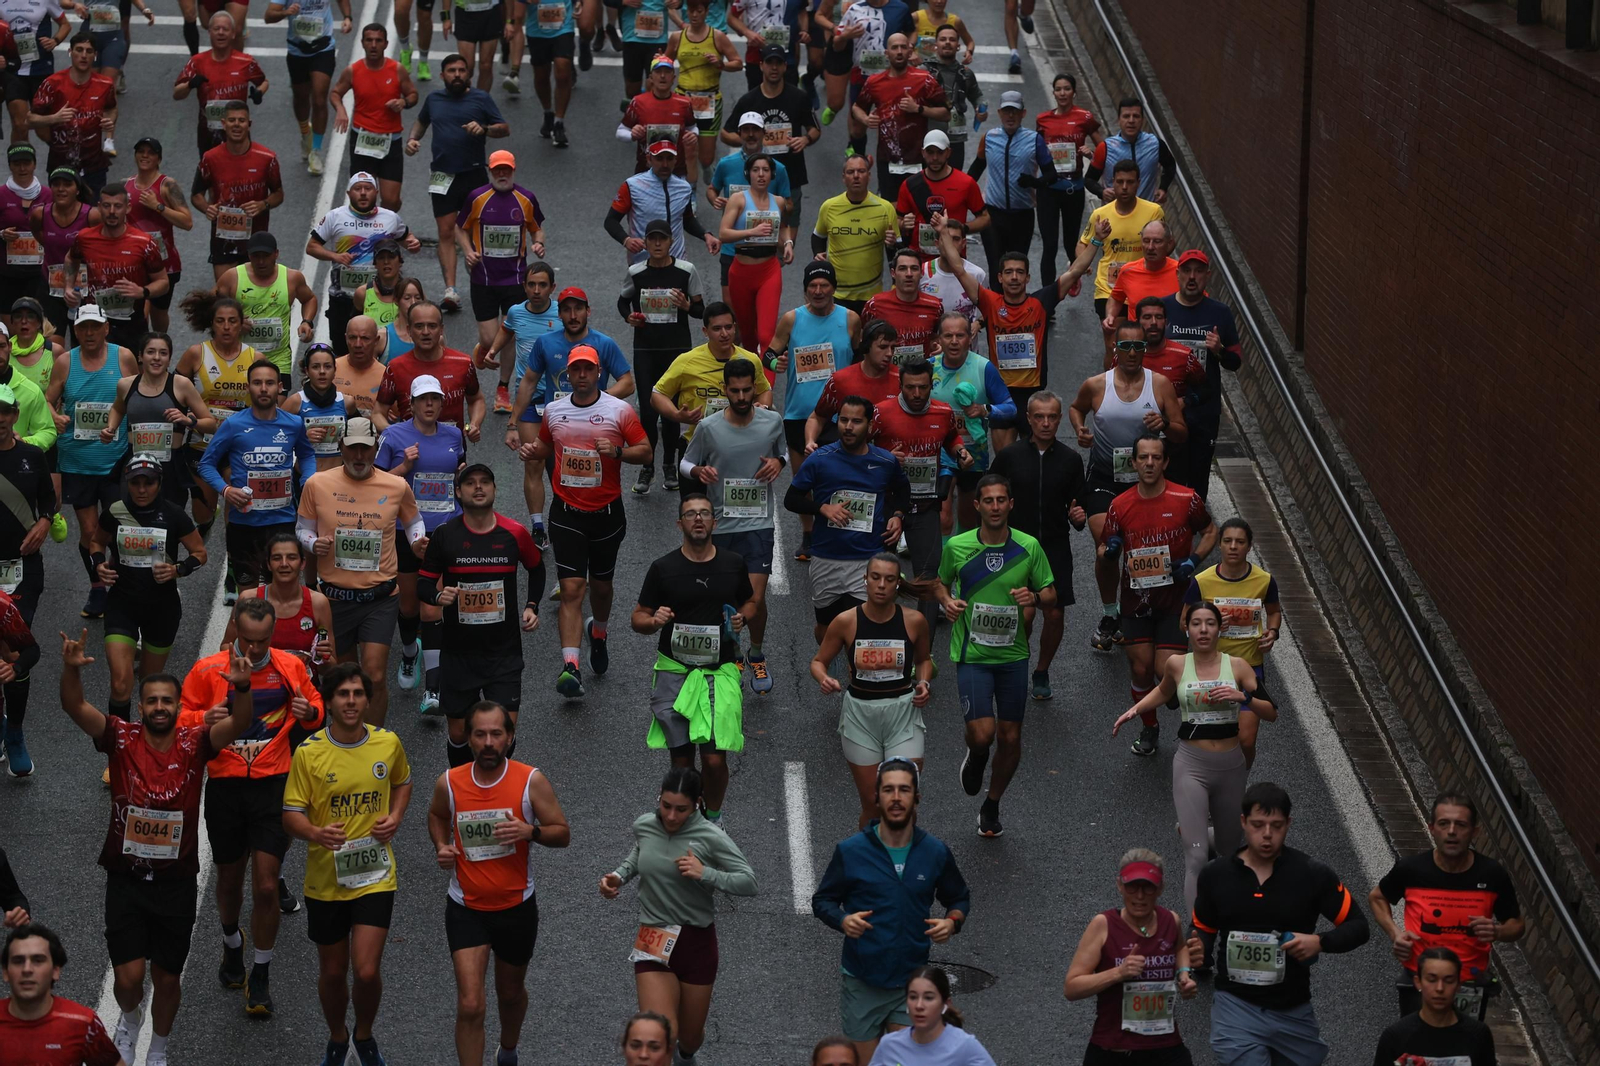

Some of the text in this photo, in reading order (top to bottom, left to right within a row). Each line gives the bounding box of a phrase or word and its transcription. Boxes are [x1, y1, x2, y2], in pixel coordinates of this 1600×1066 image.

[360, 133, 387, 148] 10340
[221, 213, 244, 227] 5094
[488, 232, 512, 245] 9177
[831, 226, 879, 237] OSUNA
[12, 238, 38, 251] 5014
[345, 272, 370, 285] 7297
[102, 292, 129, 307] 8152
[645, 297, 670, 309] 7053
[248, 326, 274, 340] 6960
[1171, 324, 1212, 338] Running
[1001, 341, 1027, 355] 1539
[800, 352, 825, 368] 3981
[81, 410, 109, 425] 6976
[136, 431, 165, 446] 8507
[566, 457, 592, 472] 4663
[903, 466, 929, 480] 6897
[258, 480, 280, 494] 321
[419, 481, 447, 496] 2703
[730, 488, 758, 502] 8578
[123, 535, 154, 551] 8046
[340, 537, 373, 554] 6944
[455, 555, 509, 566] PRORUNNERS
[1131, 556, 1162, 575] 6040
[464, 591, 495, 608] 5703
[975, 612, 1013, 630] 10062
[674, 632, 713, 651] 10179
[861, 649, 894, 665] 5518
[330, 801, 383, 819] SHIKARI
[133, 819, 171, 839] 6044
[465, 821, 494, 839] 940
[344, 851, 379, 870] 7769
[1235, 944, 1273, 964] 7365
[1131, 993, 1166, 1014] 8110
